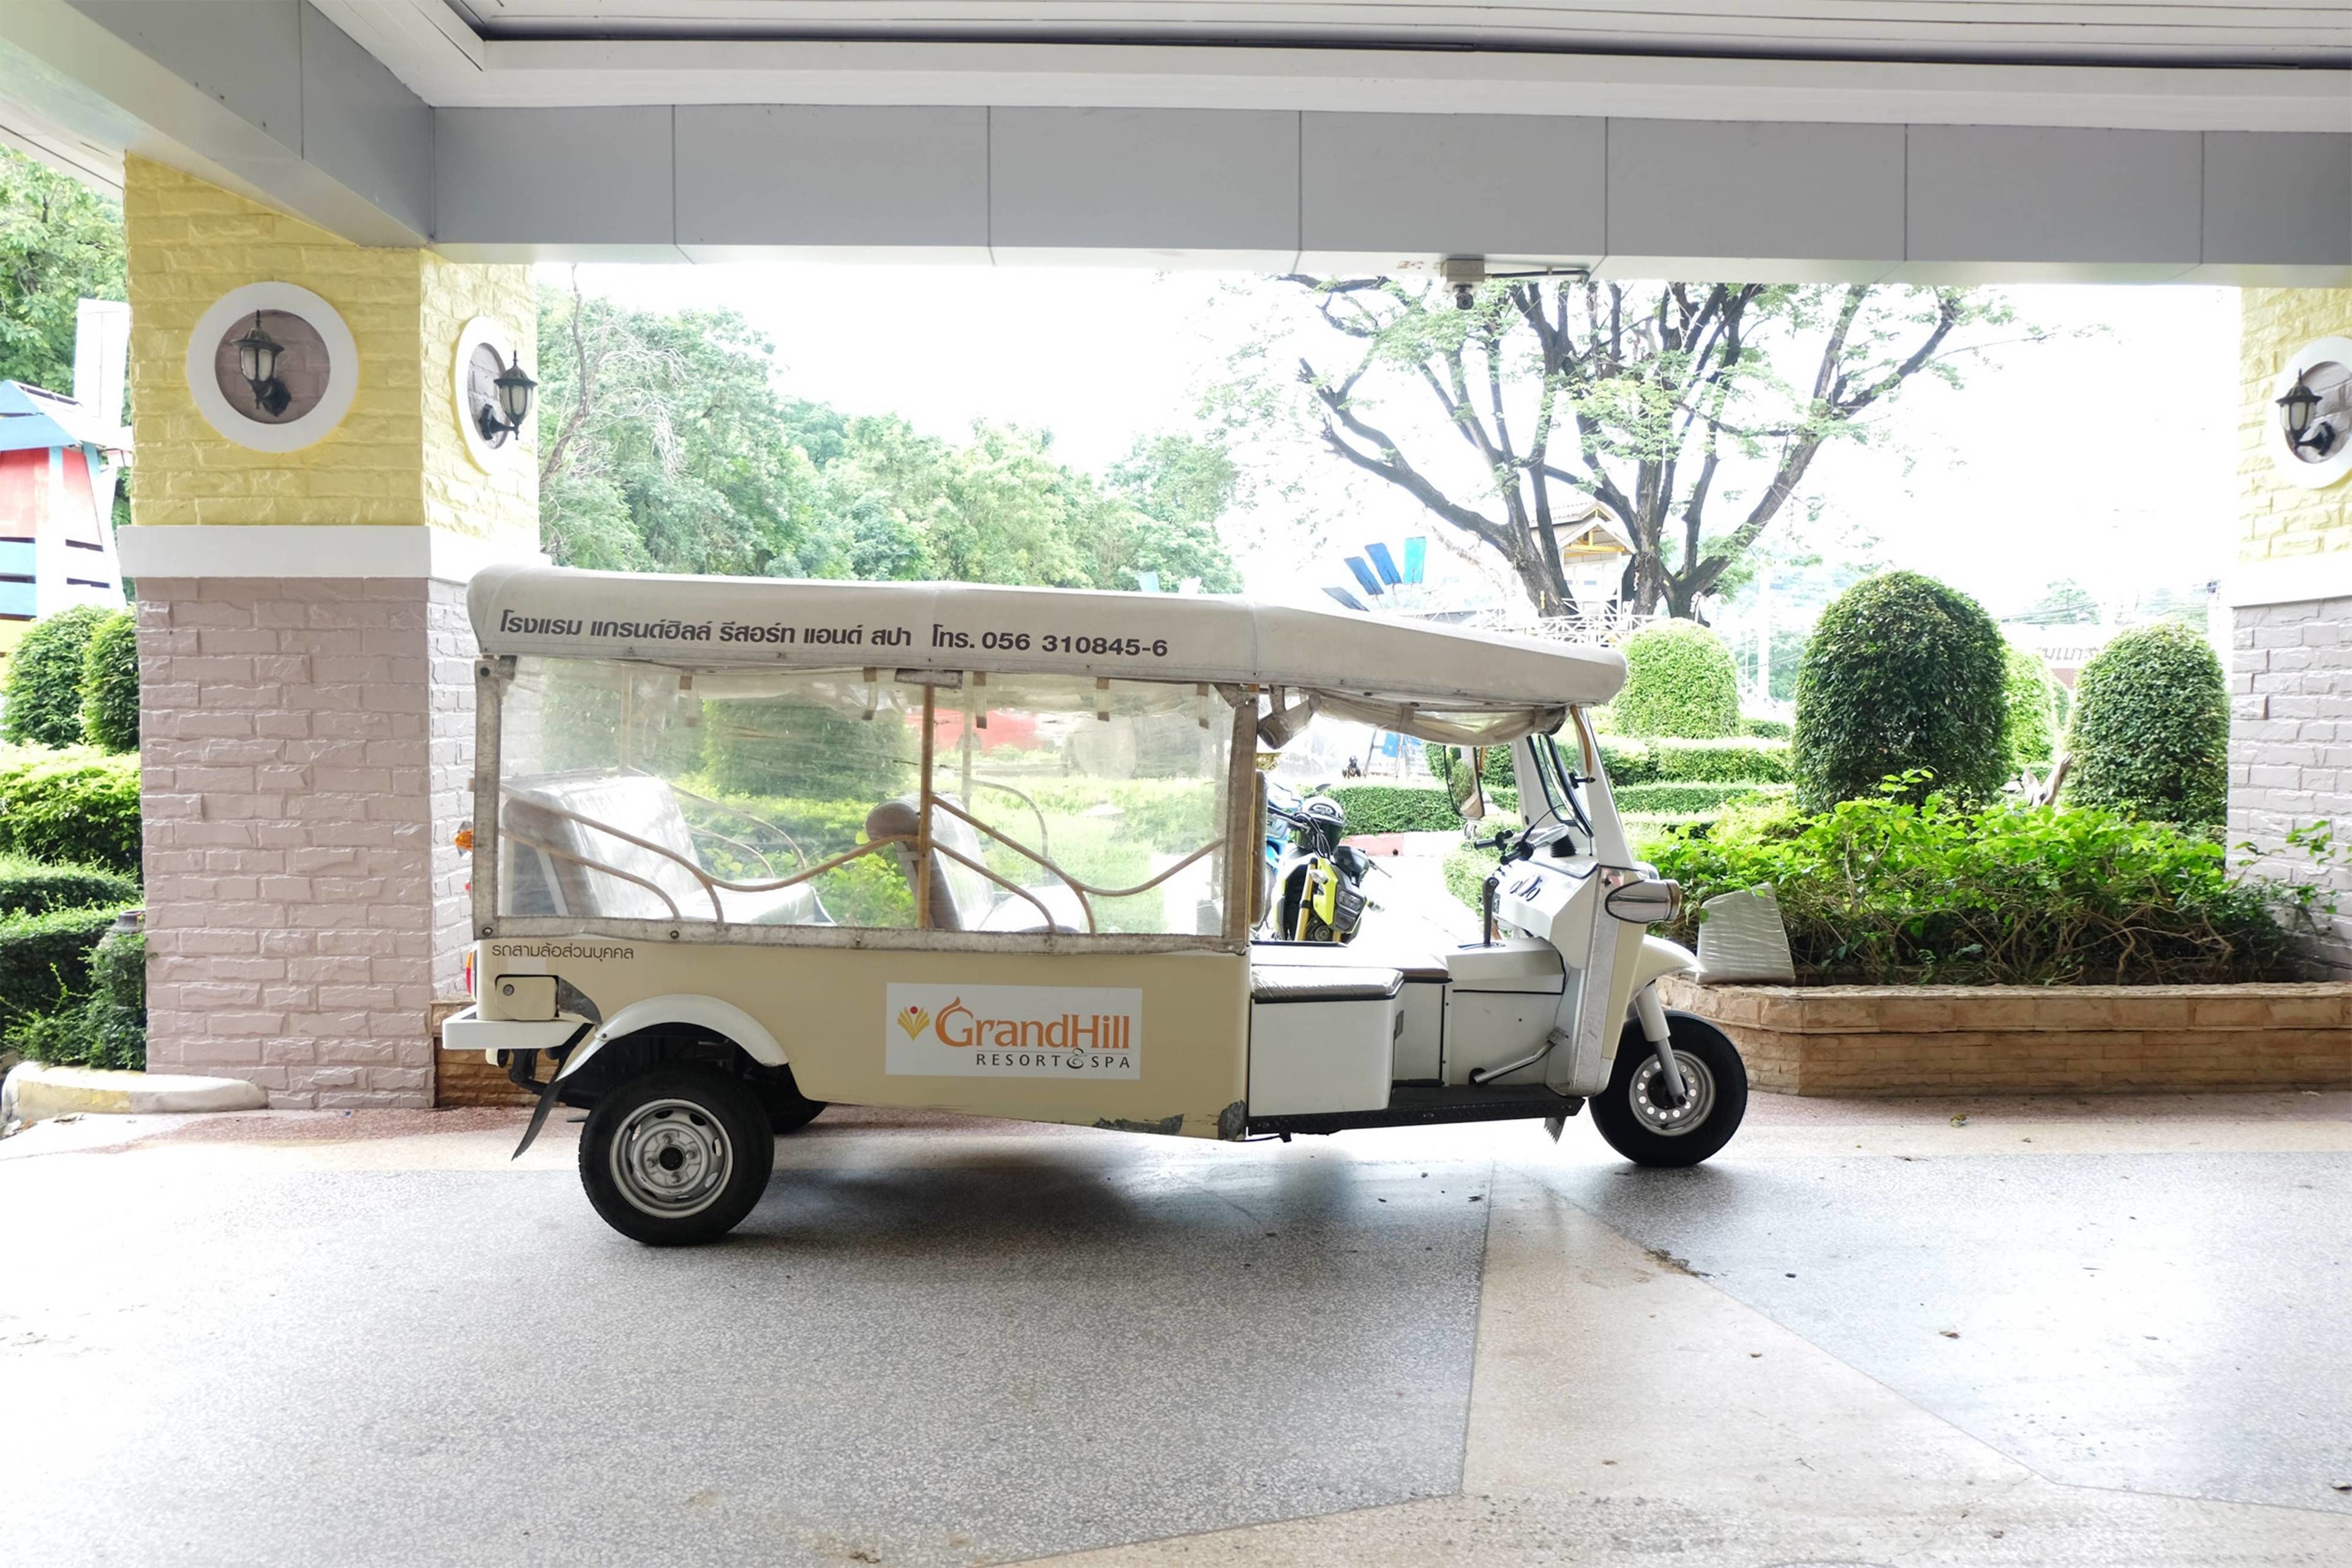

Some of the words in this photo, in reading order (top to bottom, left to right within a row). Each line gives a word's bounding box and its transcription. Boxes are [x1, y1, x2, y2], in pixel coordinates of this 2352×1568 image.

[500, 609, 583, 636] โรงแรม
[590, 619, 713, 641] แกรนด์ฮิลล์
[718, 621, 796, 644] รีสอร์ท
[803, 624, 863, 645] แอนด์
[870, 627, 911, 646] สปา
[981, 631, 1031, 651] 056
[1041, 635, 1168, 657] 310845-6
[491, 941, 634, 963] รถสามล้อส่วนบุคคล
[935, 995, 1131, 1049] GrandHill
[976, 1053, 1061, 1067] RESORT
[1091, 1055, 1130, 1069] SPA
